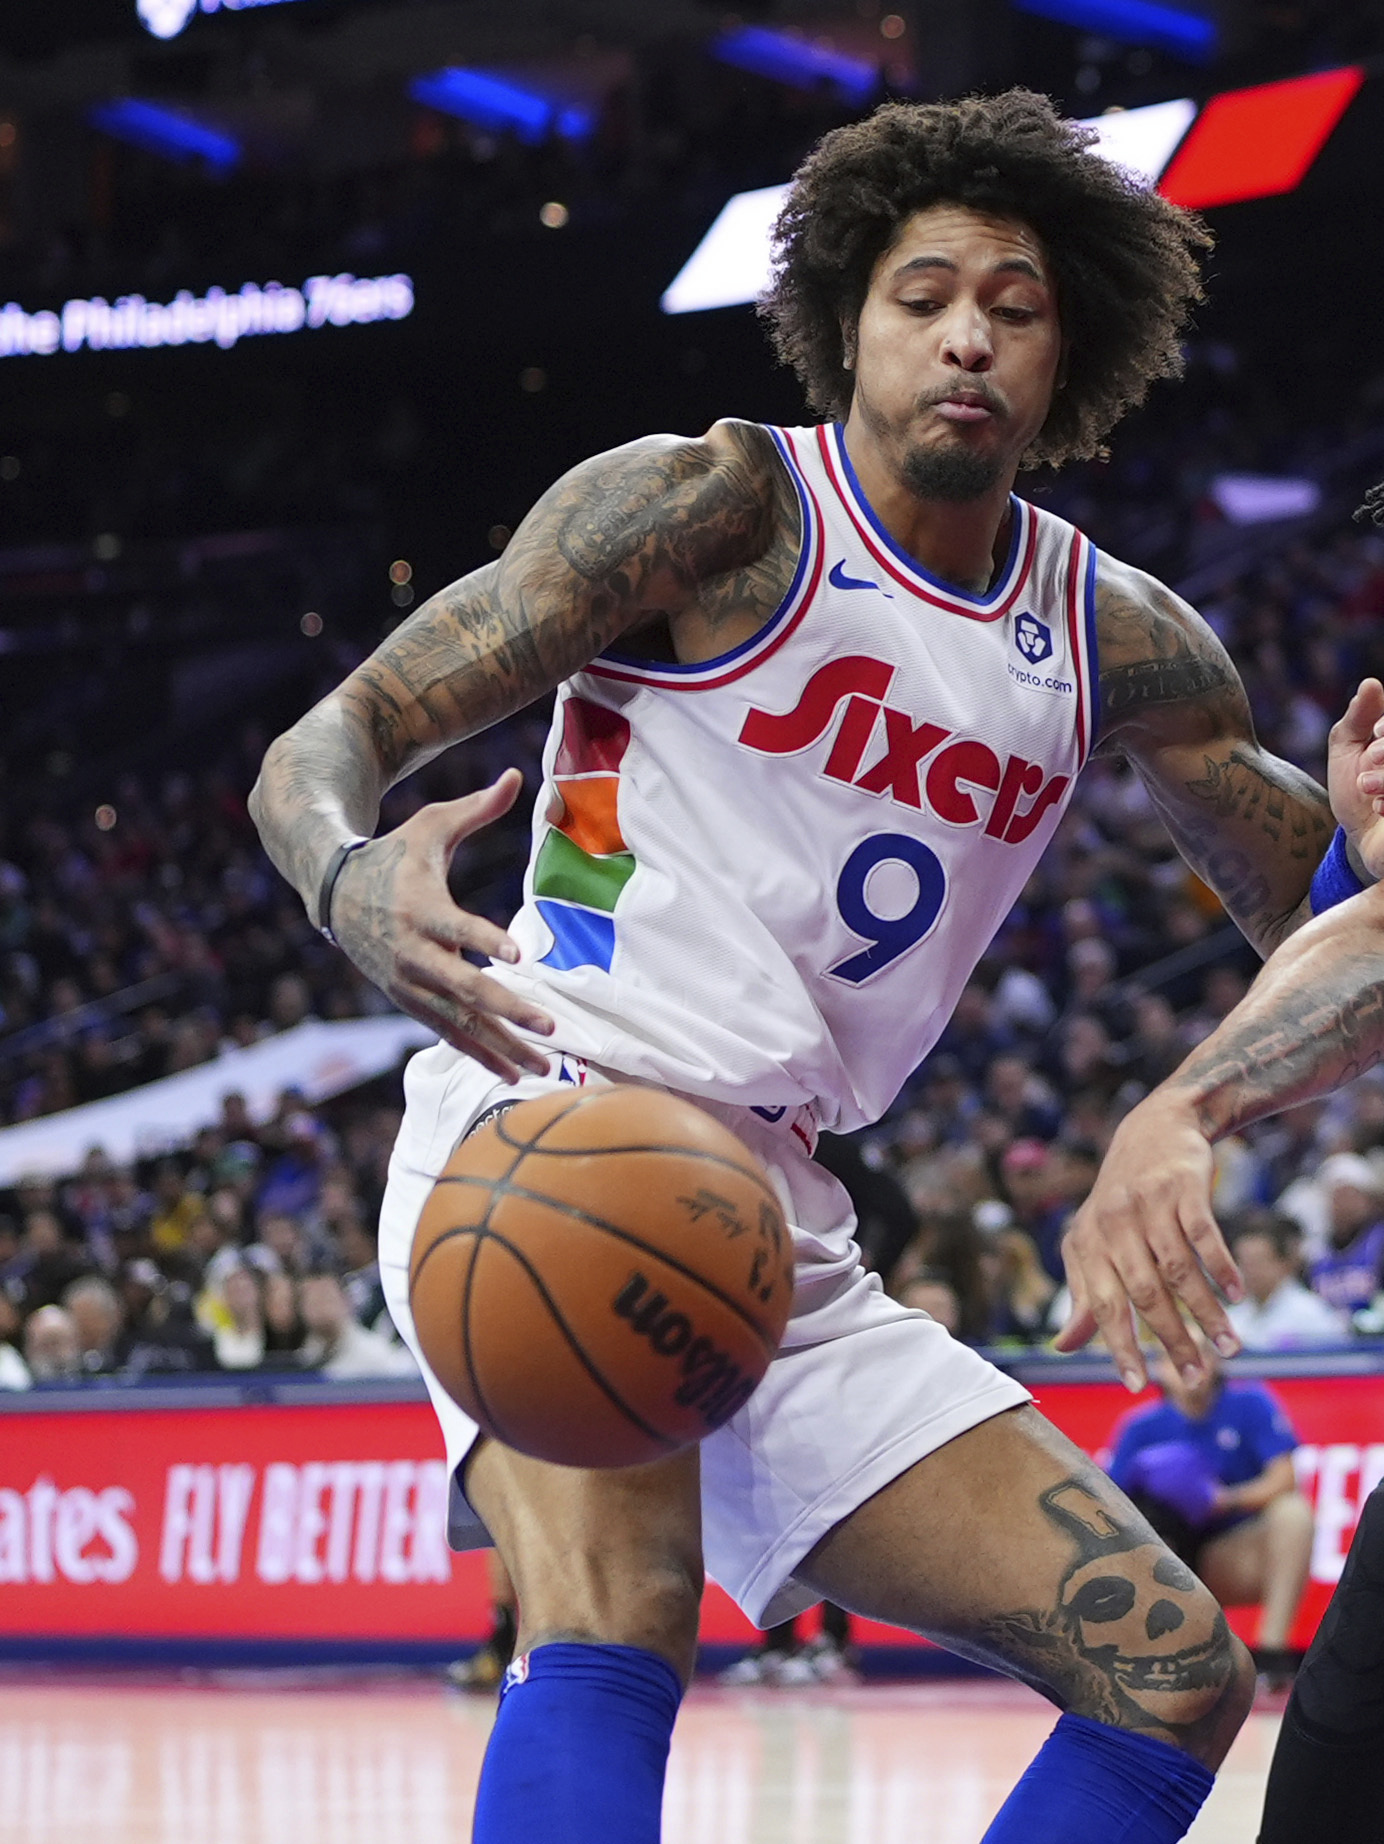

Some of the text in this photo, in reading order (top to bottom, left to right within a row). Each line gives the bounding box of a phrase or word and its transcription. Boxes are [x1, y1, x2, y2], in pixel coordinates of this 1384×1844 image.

[62, 280, 305, 351] Philadelphia
[303, 273, 413, 328] 76ers
[1007, 663, 1073, 694] crypto.com
[737, 655, 1070, 846] Sixers
[822, 830, 948, 987] 9
[158, 1462, 256, 1584] FLY
[256, 1458, 453, 1584] BETTER
